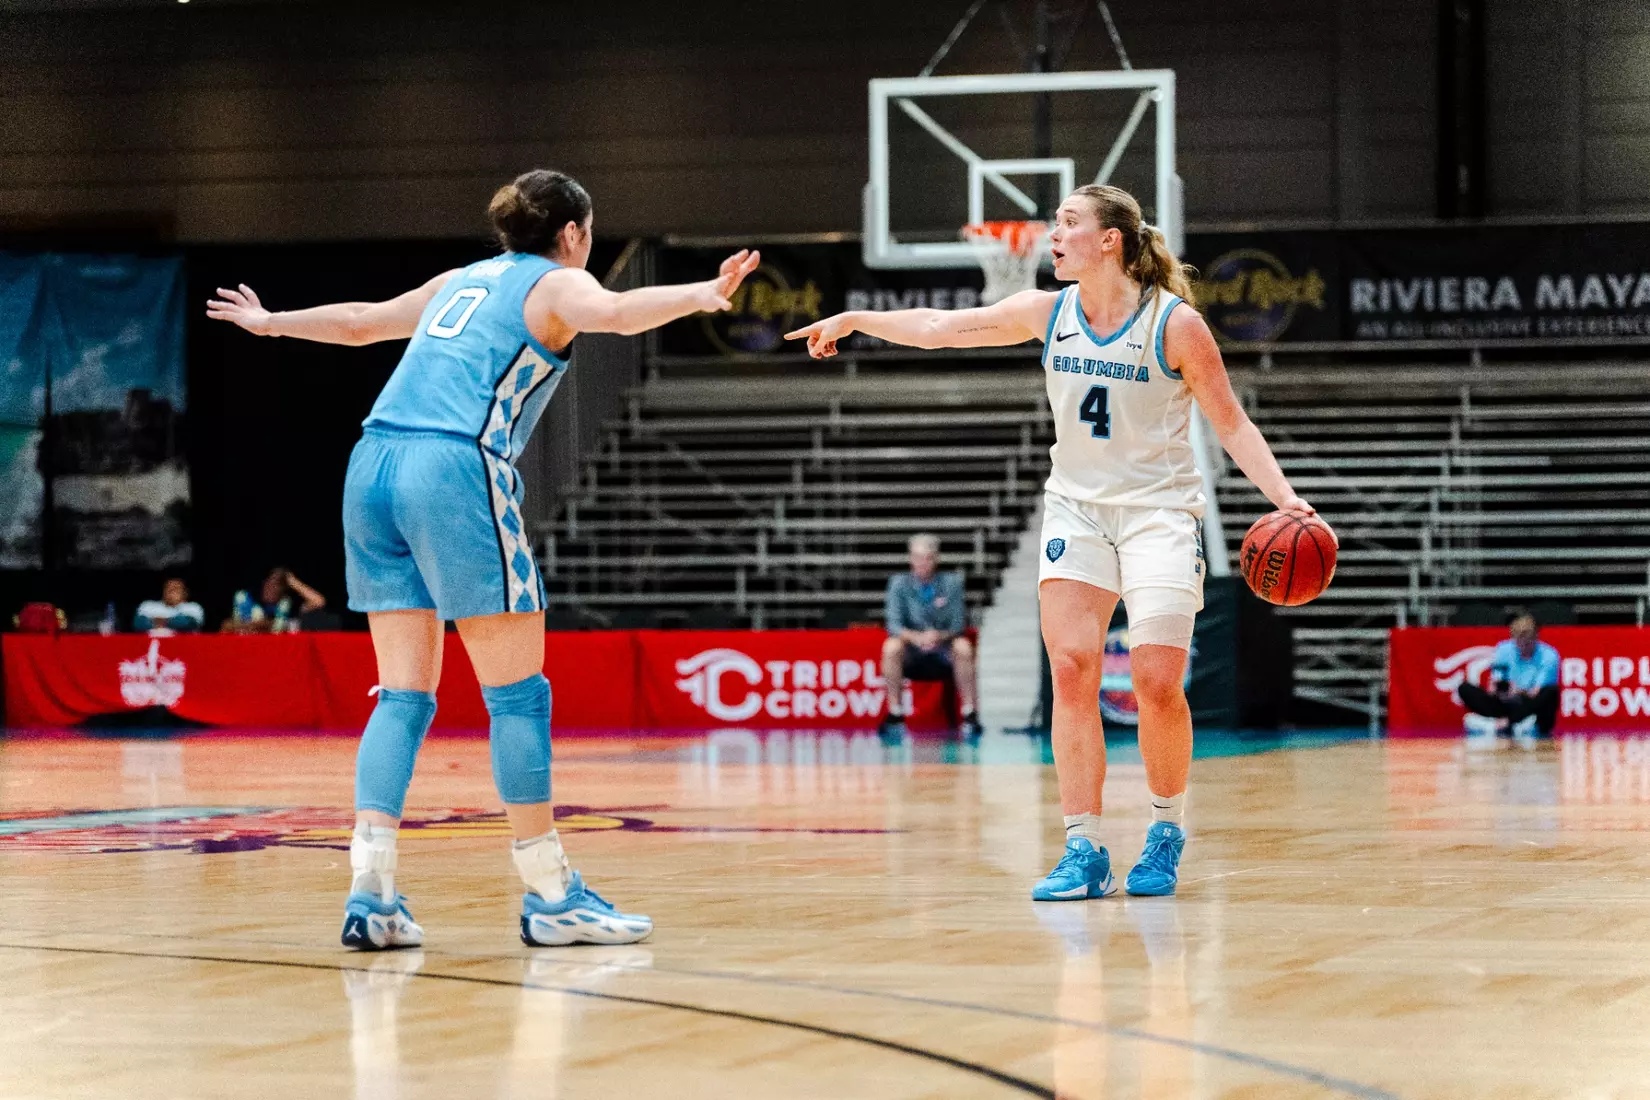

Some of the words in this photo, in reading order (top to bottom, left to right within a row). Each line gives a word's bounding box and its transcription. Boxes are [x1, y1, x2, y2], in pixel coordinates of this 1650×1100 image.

[1350, 276, 1522, 313] RIVIERA
[1535, 273, 1650, 309] MAYA
[426, 286, 490, 340] 0
[1053, 355, 1150, 382] COLUMBIA
[1079, 384, 1111, 440] 4
[764, 659, 887, 690] TRIPL
[1560, 656, 1650, 687] RIPL
[1560, 687, 1650, 717] ROW
